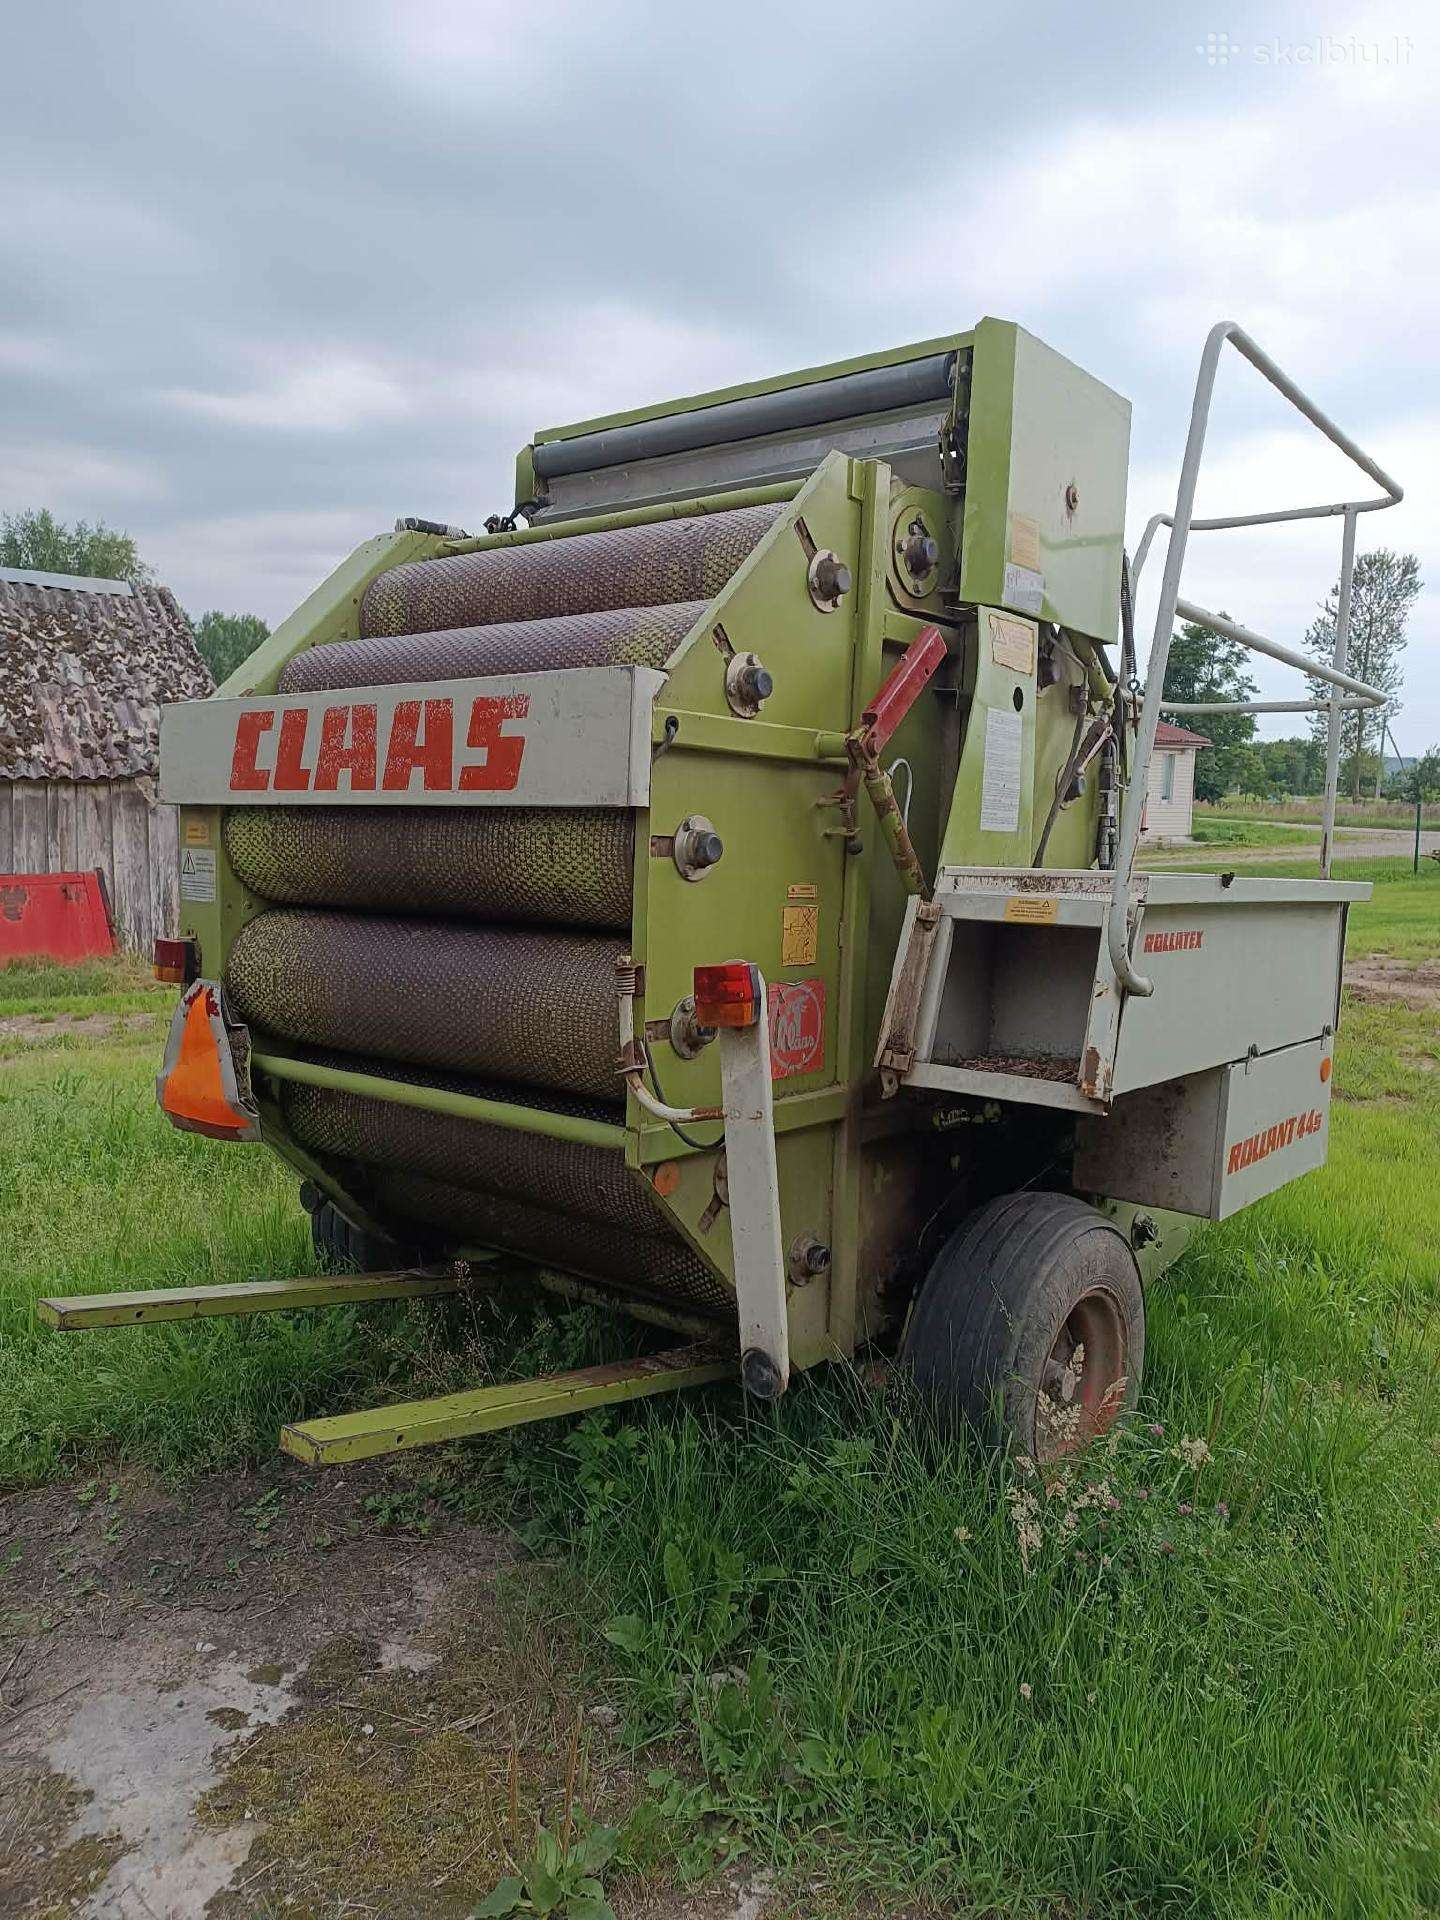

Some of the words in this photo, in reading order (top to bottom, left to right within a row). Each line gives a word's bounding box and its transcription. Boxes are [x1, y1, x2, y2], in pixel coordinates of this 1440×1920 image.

[230, 694, 531, 791] CLAAS
[1144, 930, 1203, 953] ROLLATEX
[1227, 1116, 1298, 1175] ROLLANT
